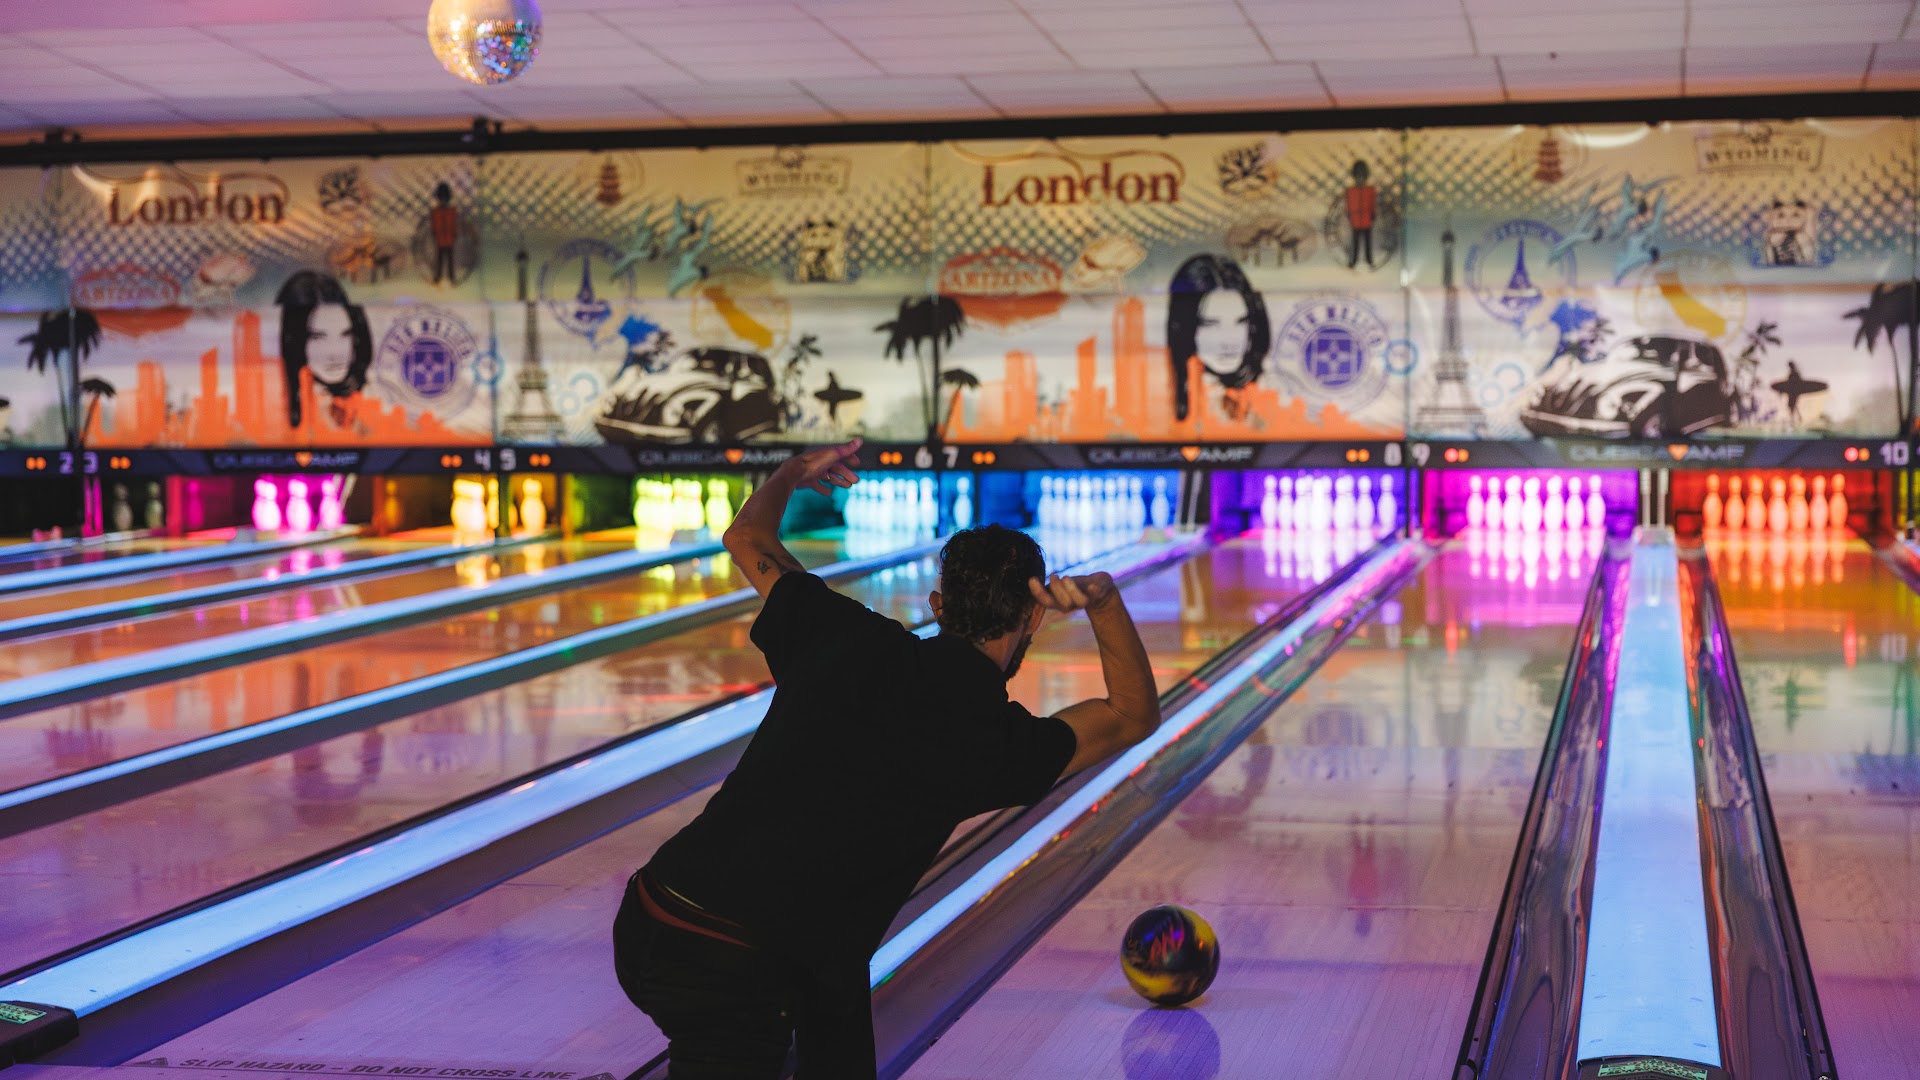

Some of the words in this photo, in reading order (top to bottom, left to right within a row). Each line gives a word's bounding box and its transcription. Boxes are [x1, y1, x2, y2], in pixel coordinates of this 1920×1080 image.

[981, 158, 1180, 207] London
[108, 174, 287, 225] London
[59, 452, 74, 474] 2
[83, 452, 98, 474] 3
[475, 450, 491, 471] 4
[915, 447, 933, 468] 6
[942, 446, 959, 468] 7
[1411, 442, 1431, 467] 9
[1880, 441, 1909, 466] 10
[179, 1058, 234, 1068] SLIP
[236, 1060, 326, 1072] HAZARD
[350, 1064, 385, 1073] DO
[386, 1065, 437, 1076] NOT
[437, 1067, 518, 1078] CROSS
[519, 1070, 577, 1080] LINE
